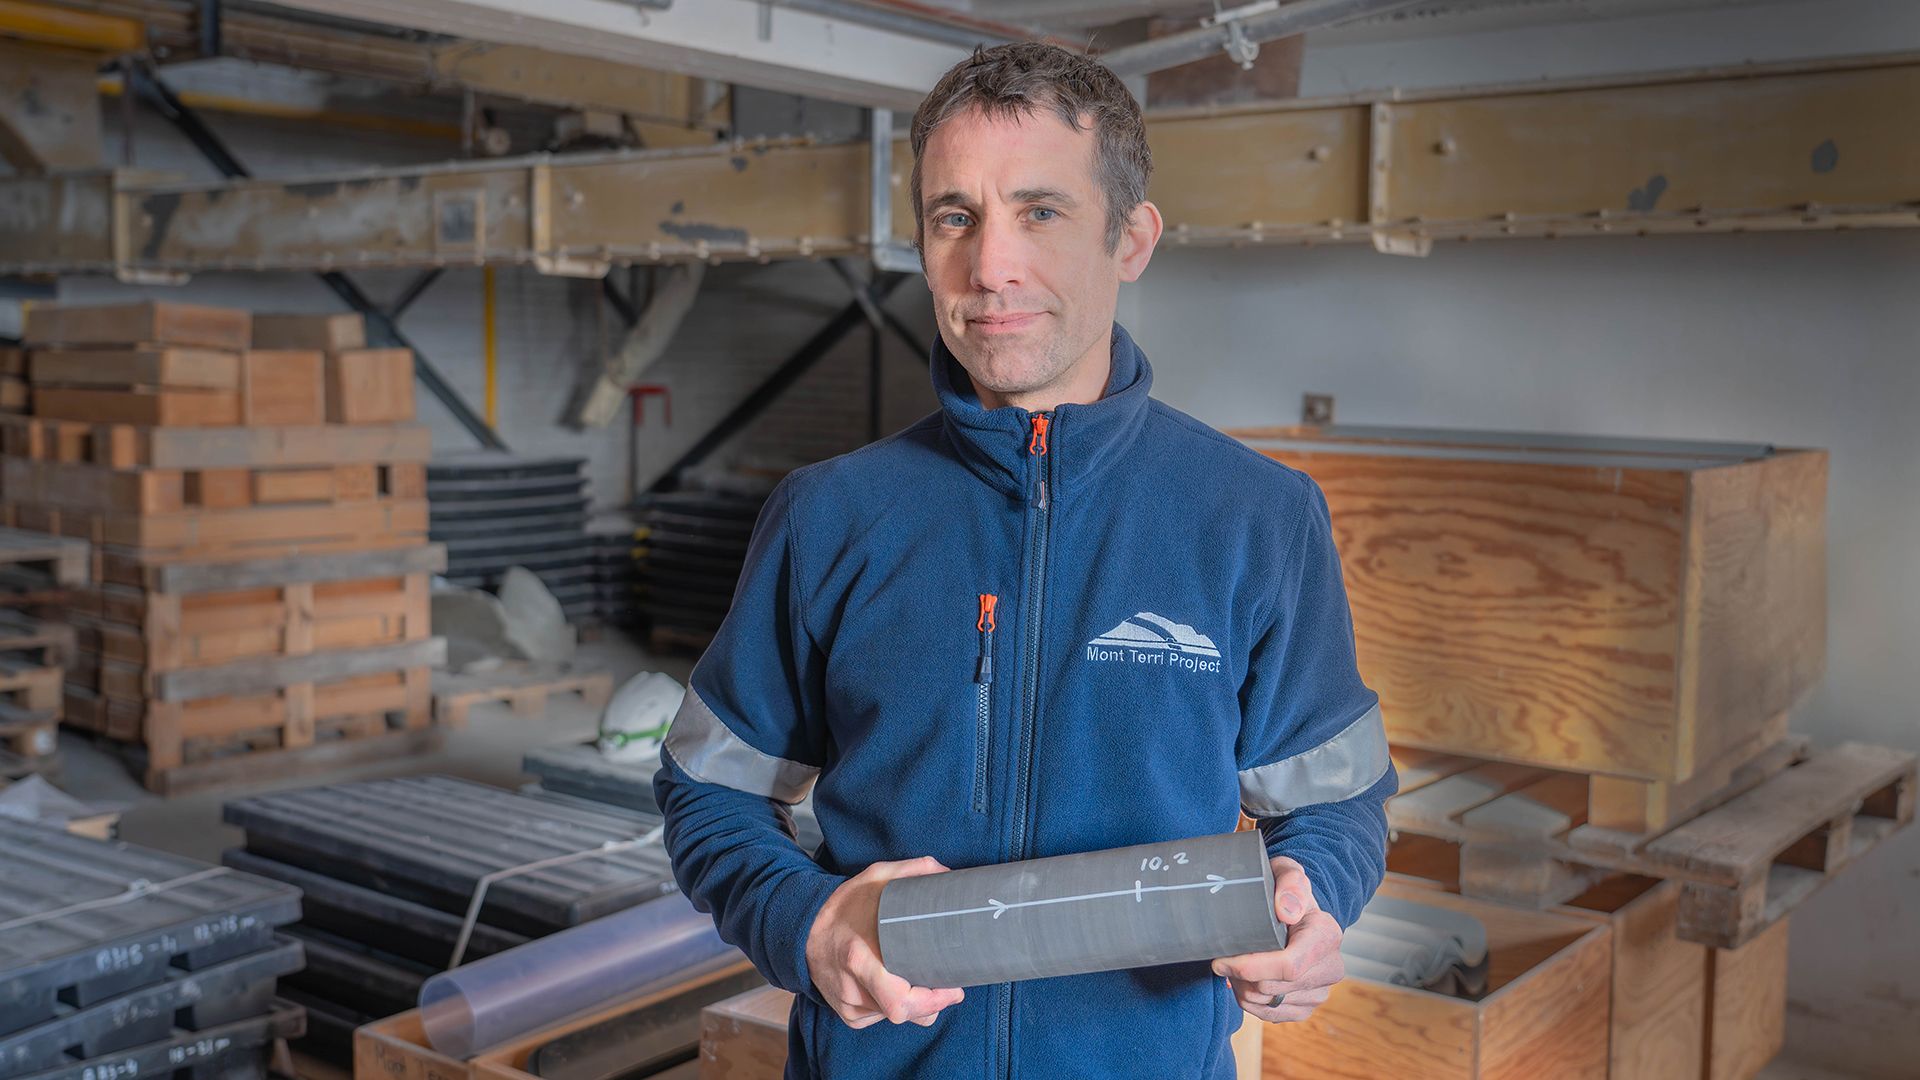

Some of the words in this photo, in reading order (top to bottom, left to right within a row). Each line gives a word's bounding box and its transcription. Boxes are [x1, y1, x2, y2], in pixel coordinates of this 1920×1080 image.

[1087, 646, 1125, 662] Mont
[1130, 650, 1164, 665] Terri
[1169, 653, 1221, 673] Project
[1140, 852, 1189, 871] 10.2
